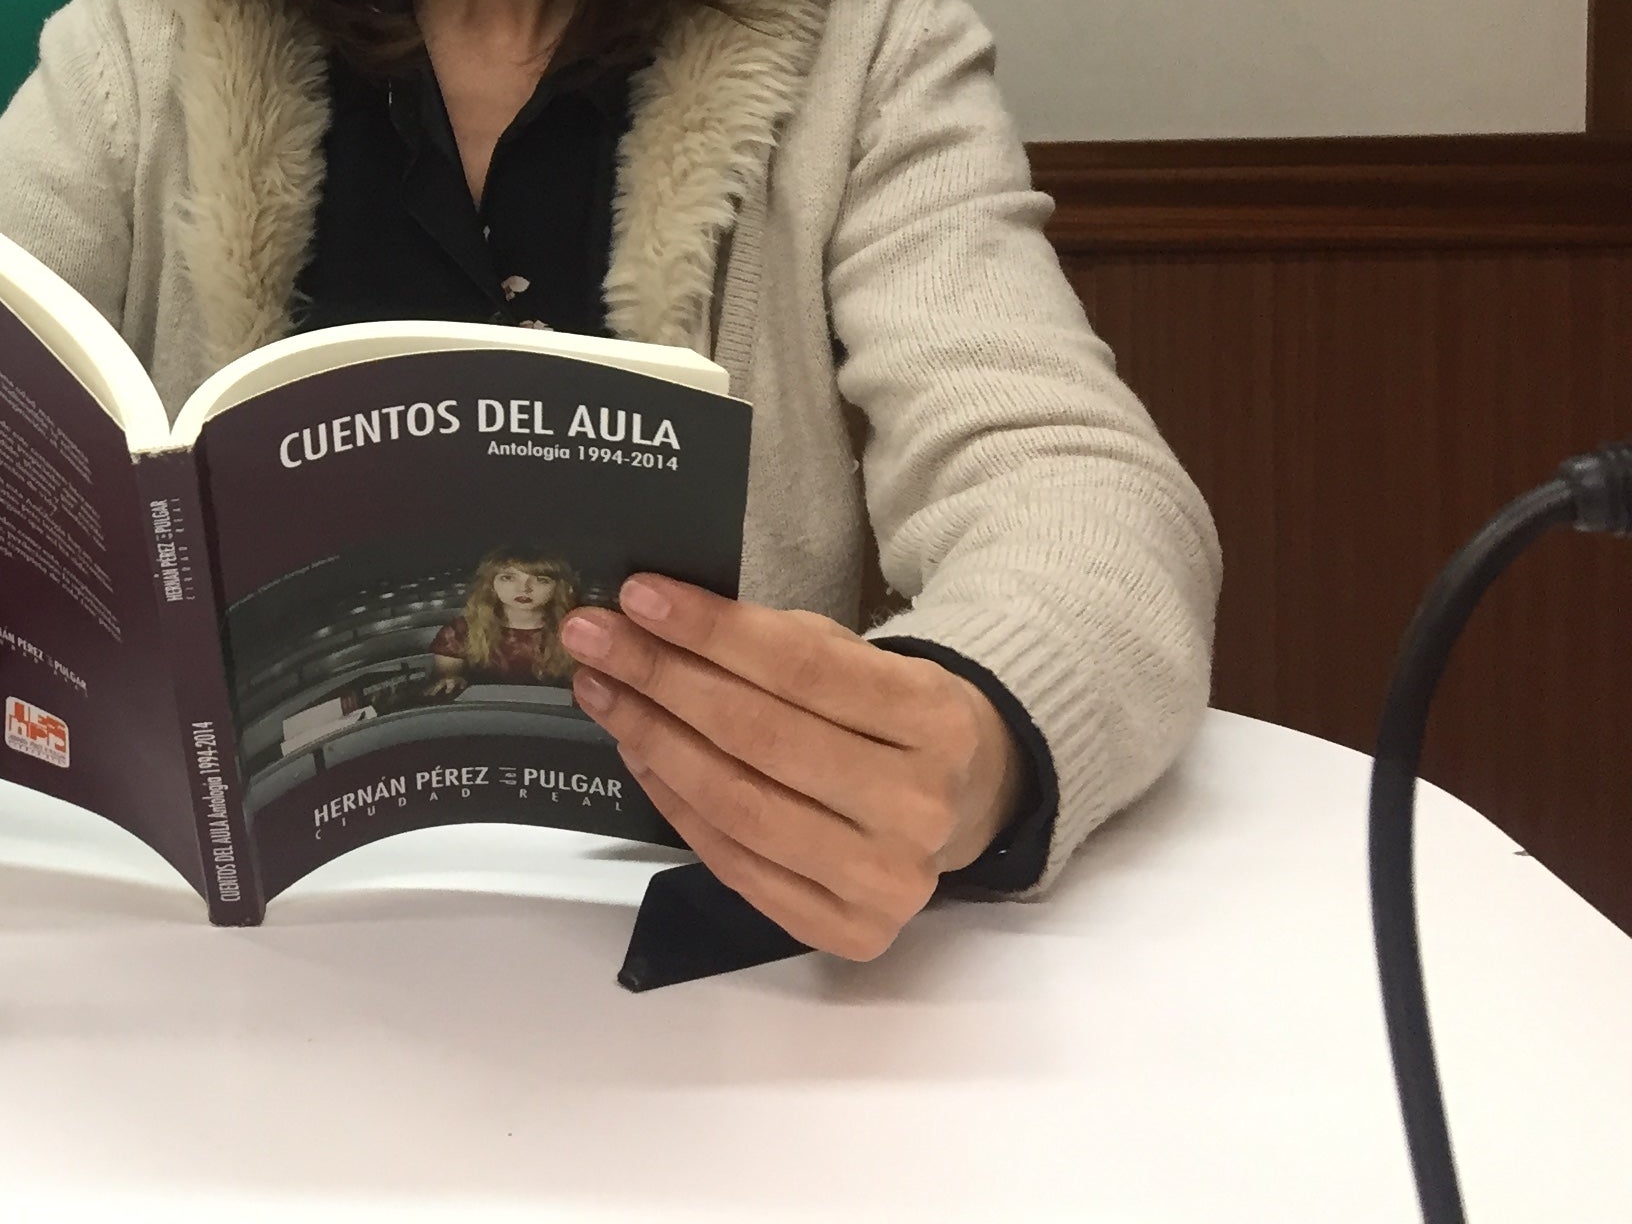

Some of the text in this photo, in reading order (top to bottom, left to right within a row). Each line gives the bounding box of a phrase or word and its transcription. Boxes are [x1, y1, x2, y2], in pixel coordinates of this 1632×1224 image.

[279, 399, 681, 468] CUENTOS DEL AULA
[487, 440, 679, 471] Antología 1994-2014
[149, 498, 172, 533] PULGAR
[192, 721, 221, 775] 1994-2014
[314, 776, 406, 827] HERNÁN
[416, 766, 490, 791] PÉREZ
[524, 768, 623, 799] PULGAR
[209, 819, 232, 844] AULA
[213, 845, 235, 862] DEL
[216, 863, 241, 903] CUENTOS
